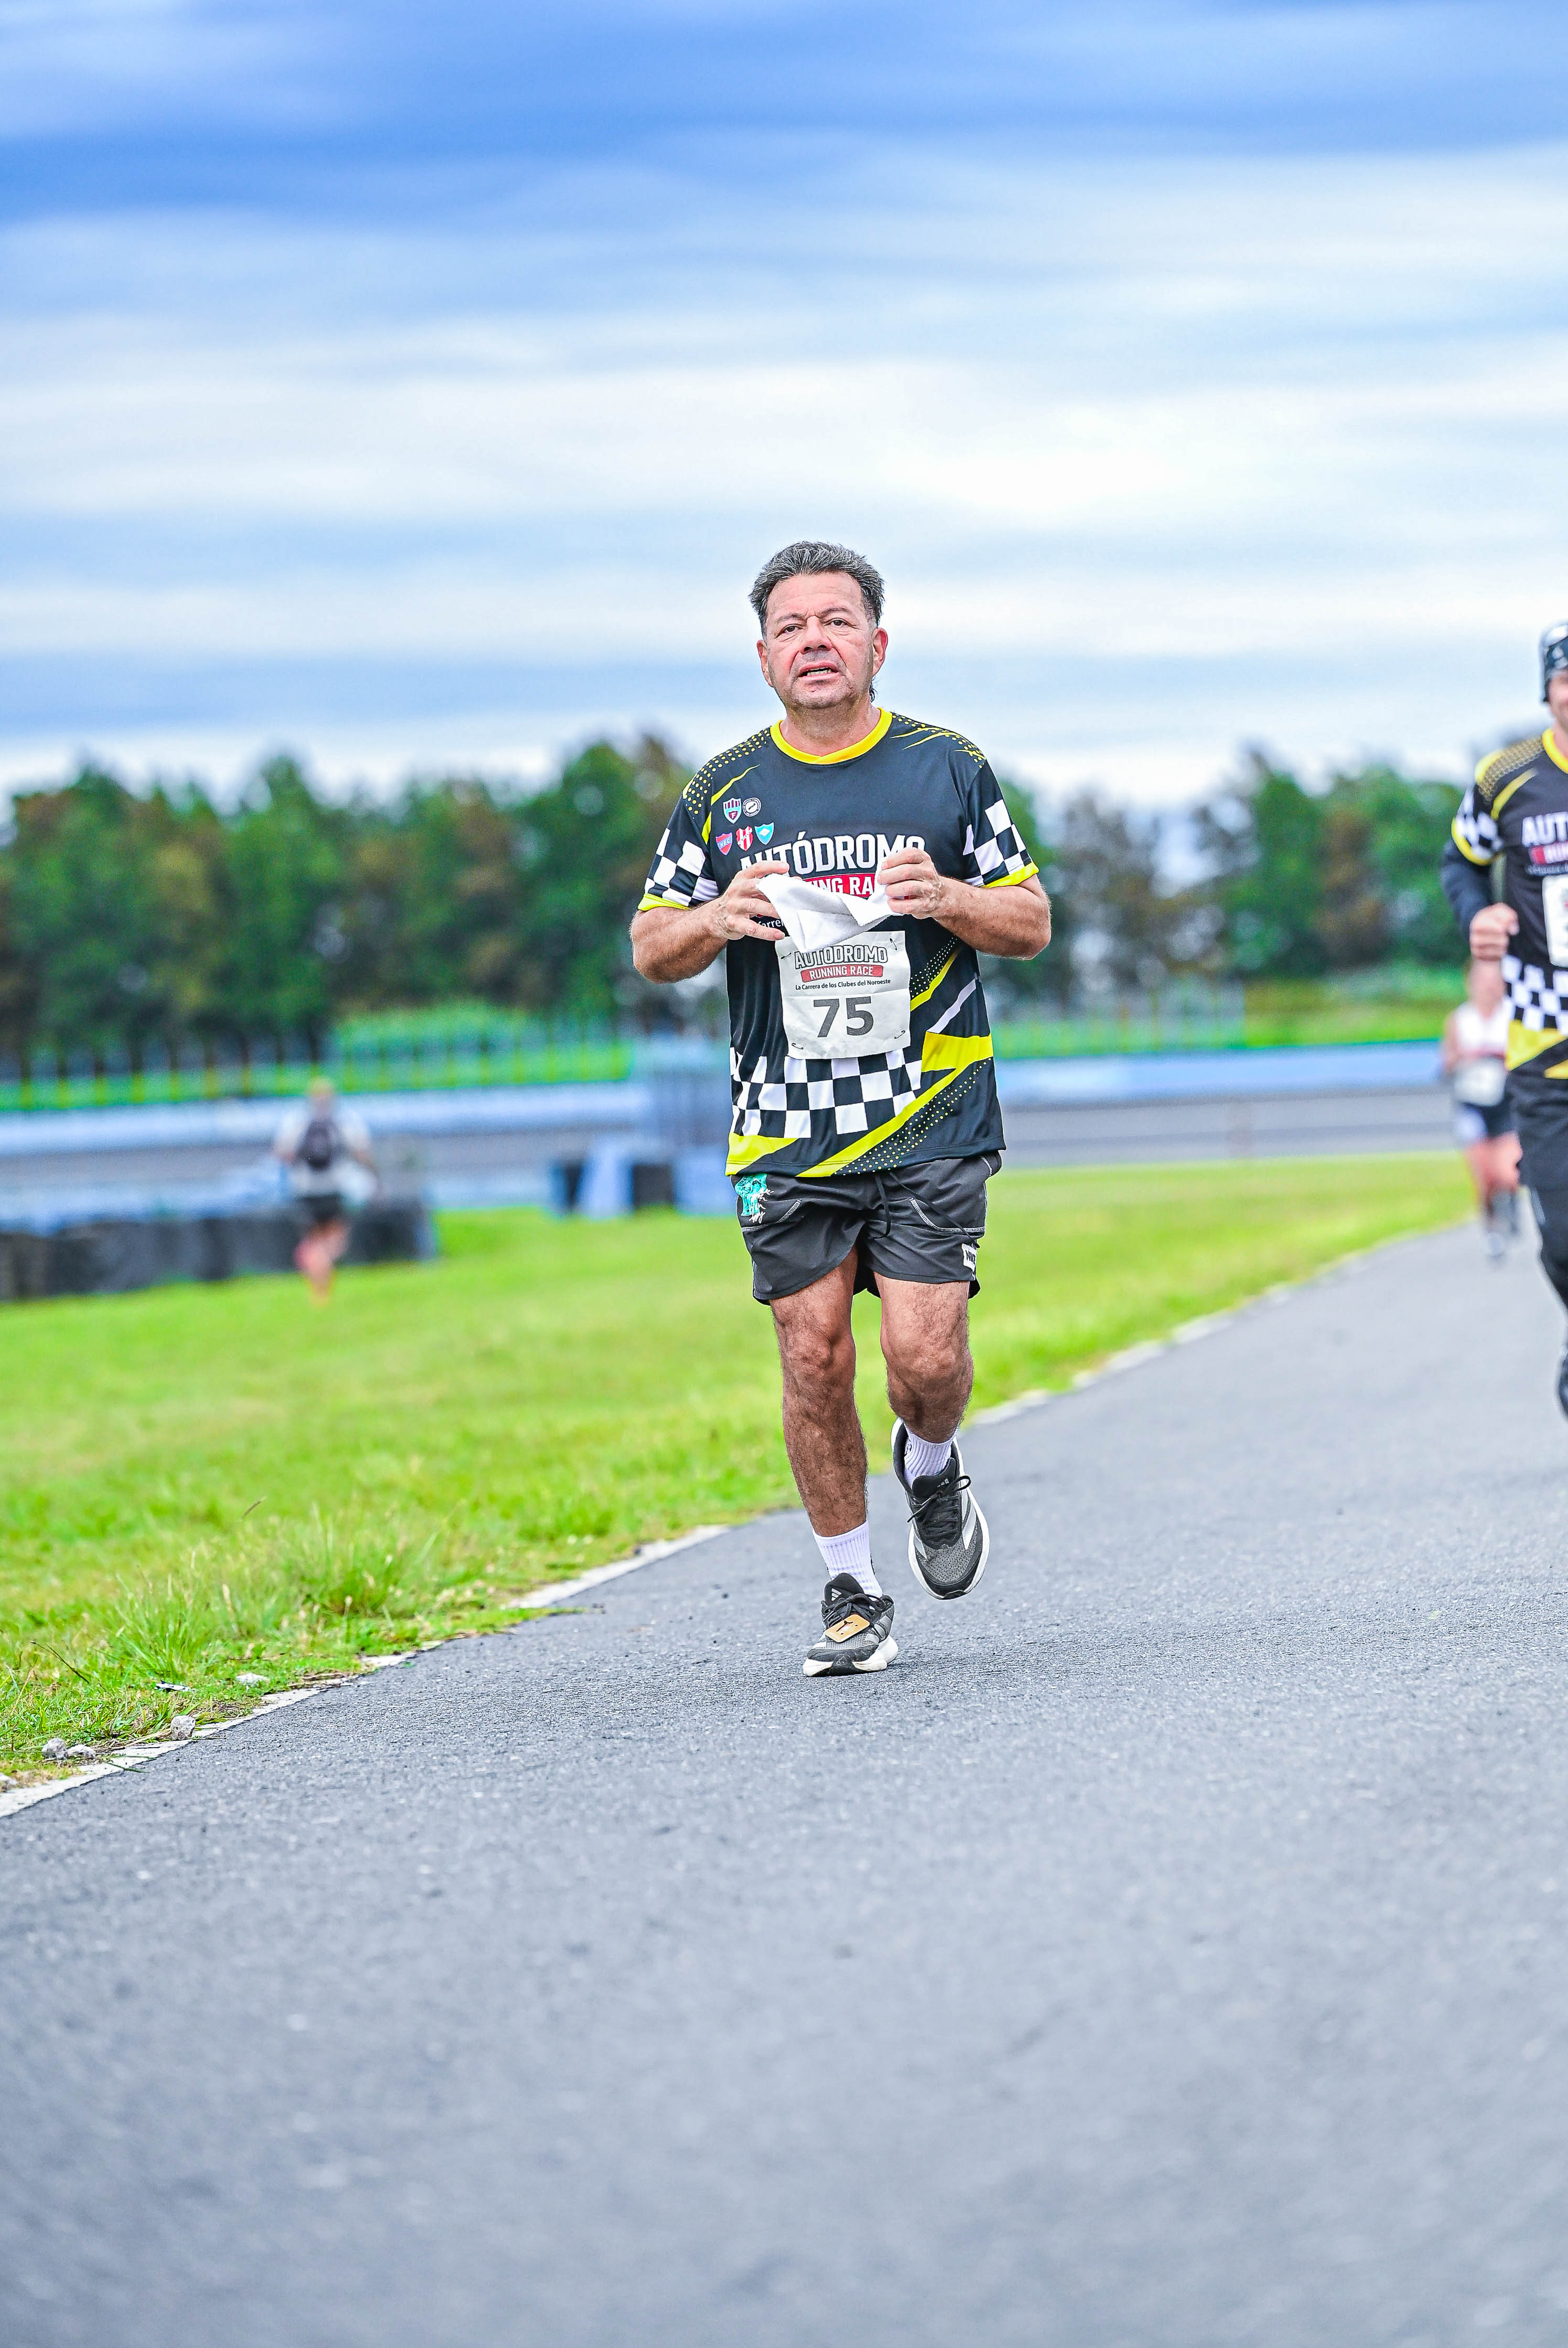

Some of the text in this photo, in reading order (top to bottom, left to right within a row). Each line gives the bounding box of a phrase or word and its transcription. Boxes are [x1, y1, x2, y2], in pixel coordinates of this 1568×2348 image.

[809, 965, 874, 981] RUNNING RACE
[814, 996, 874, 1038] 75
